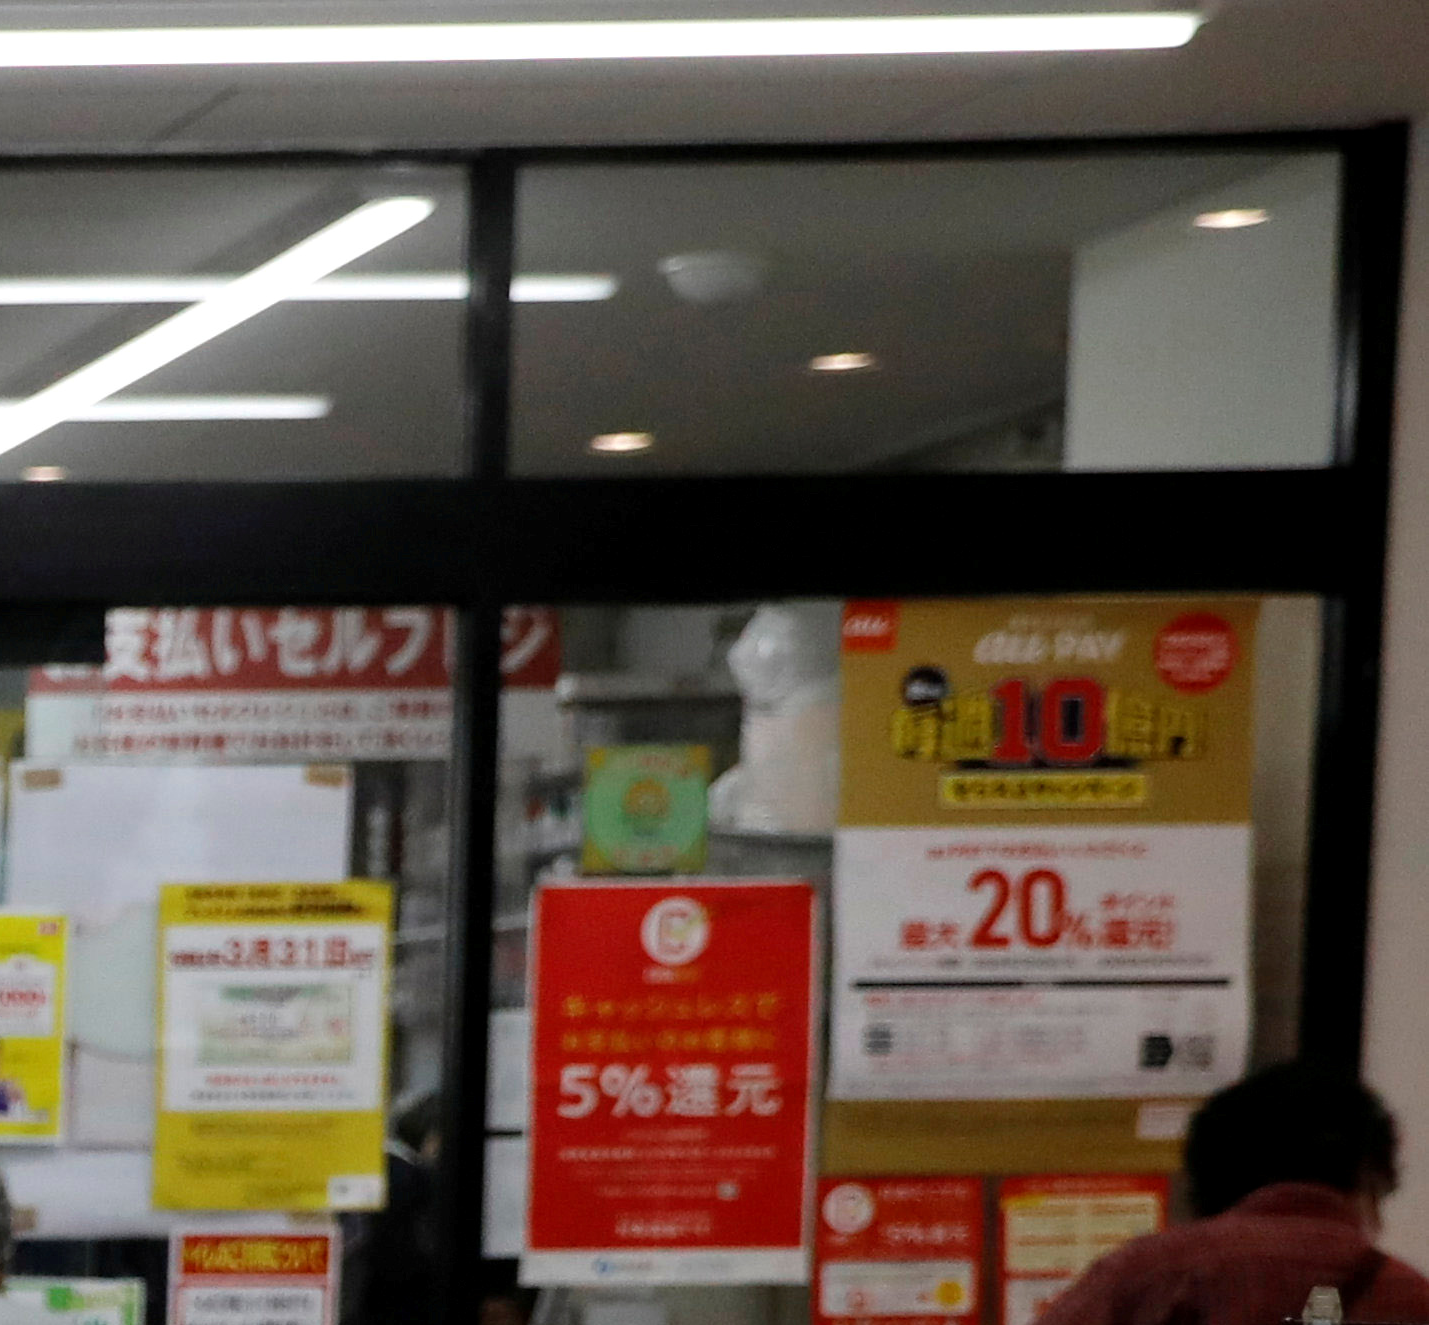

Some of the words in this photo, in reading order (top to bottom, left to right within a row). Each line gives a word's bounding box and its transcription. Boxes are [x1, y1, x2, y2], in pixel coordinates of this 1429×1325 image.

[102, 605, 456, 681] 支払いセルフ
[557, 1062, 783, 1119] 5%還元
